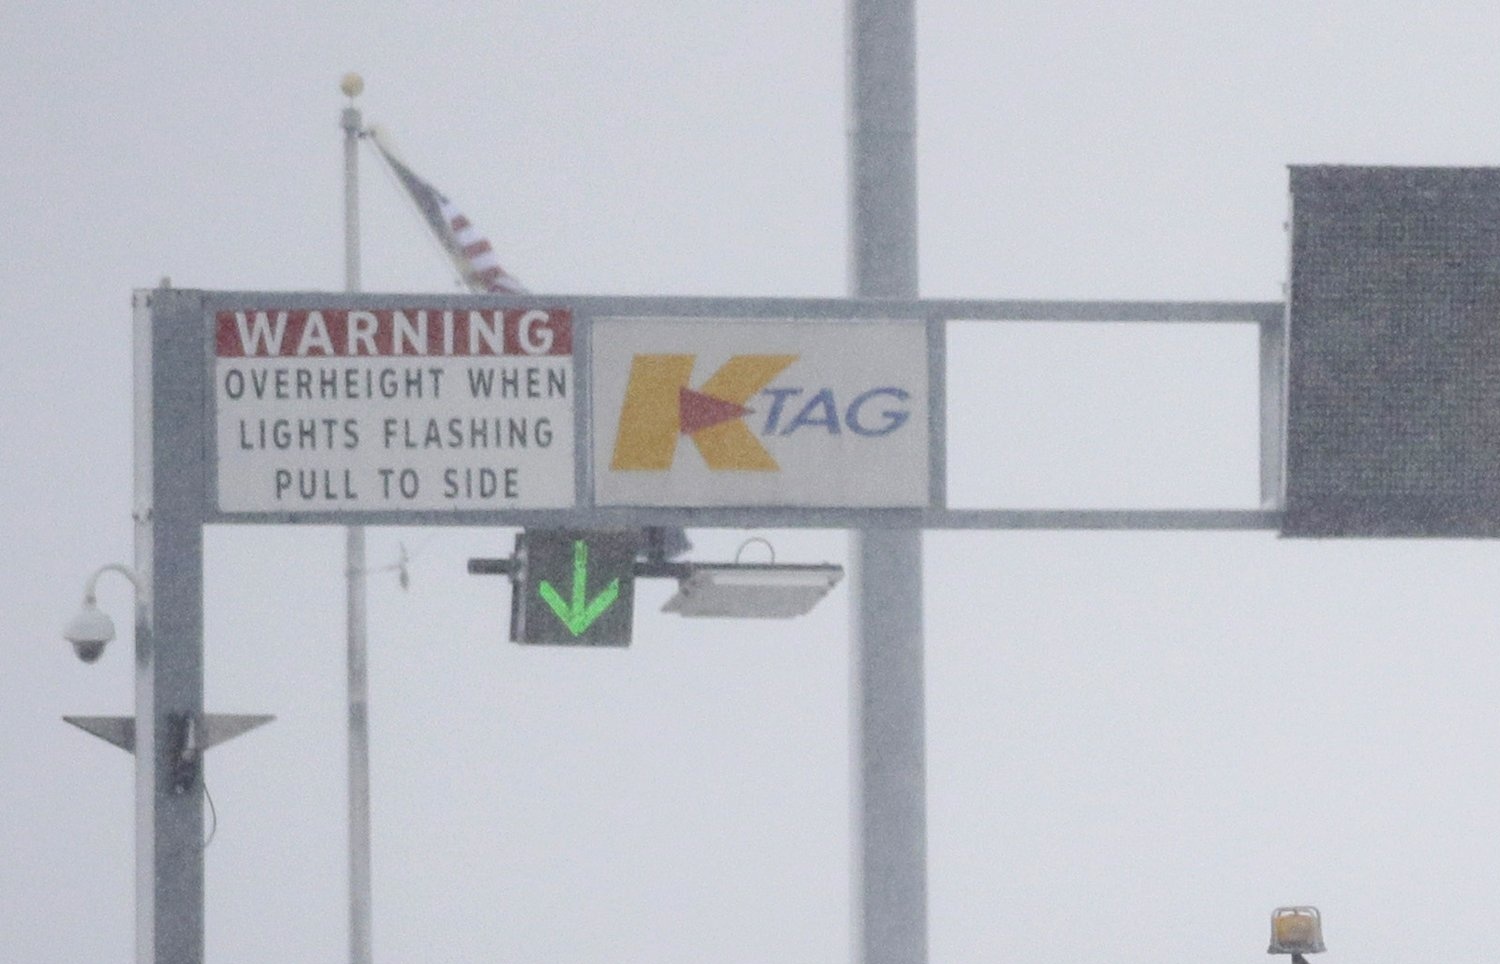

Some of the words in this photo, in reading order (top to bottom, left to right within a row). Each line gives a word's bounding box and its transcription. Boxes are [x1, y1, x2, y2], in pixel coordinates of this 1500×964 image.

[234, 310, 556, 356] WARNING
[224, 368, 446, 400] OVERHEIGHT
[467, 368, 568, 399] WHEN
[239, 418, 361, 450] LIGHTS
[382, 417, 553, 450] FLASHING
[275, 468, 359, 500] PULL
[377, 468, 421, 500] TO
[443, 468, 521, 500] SIDE
